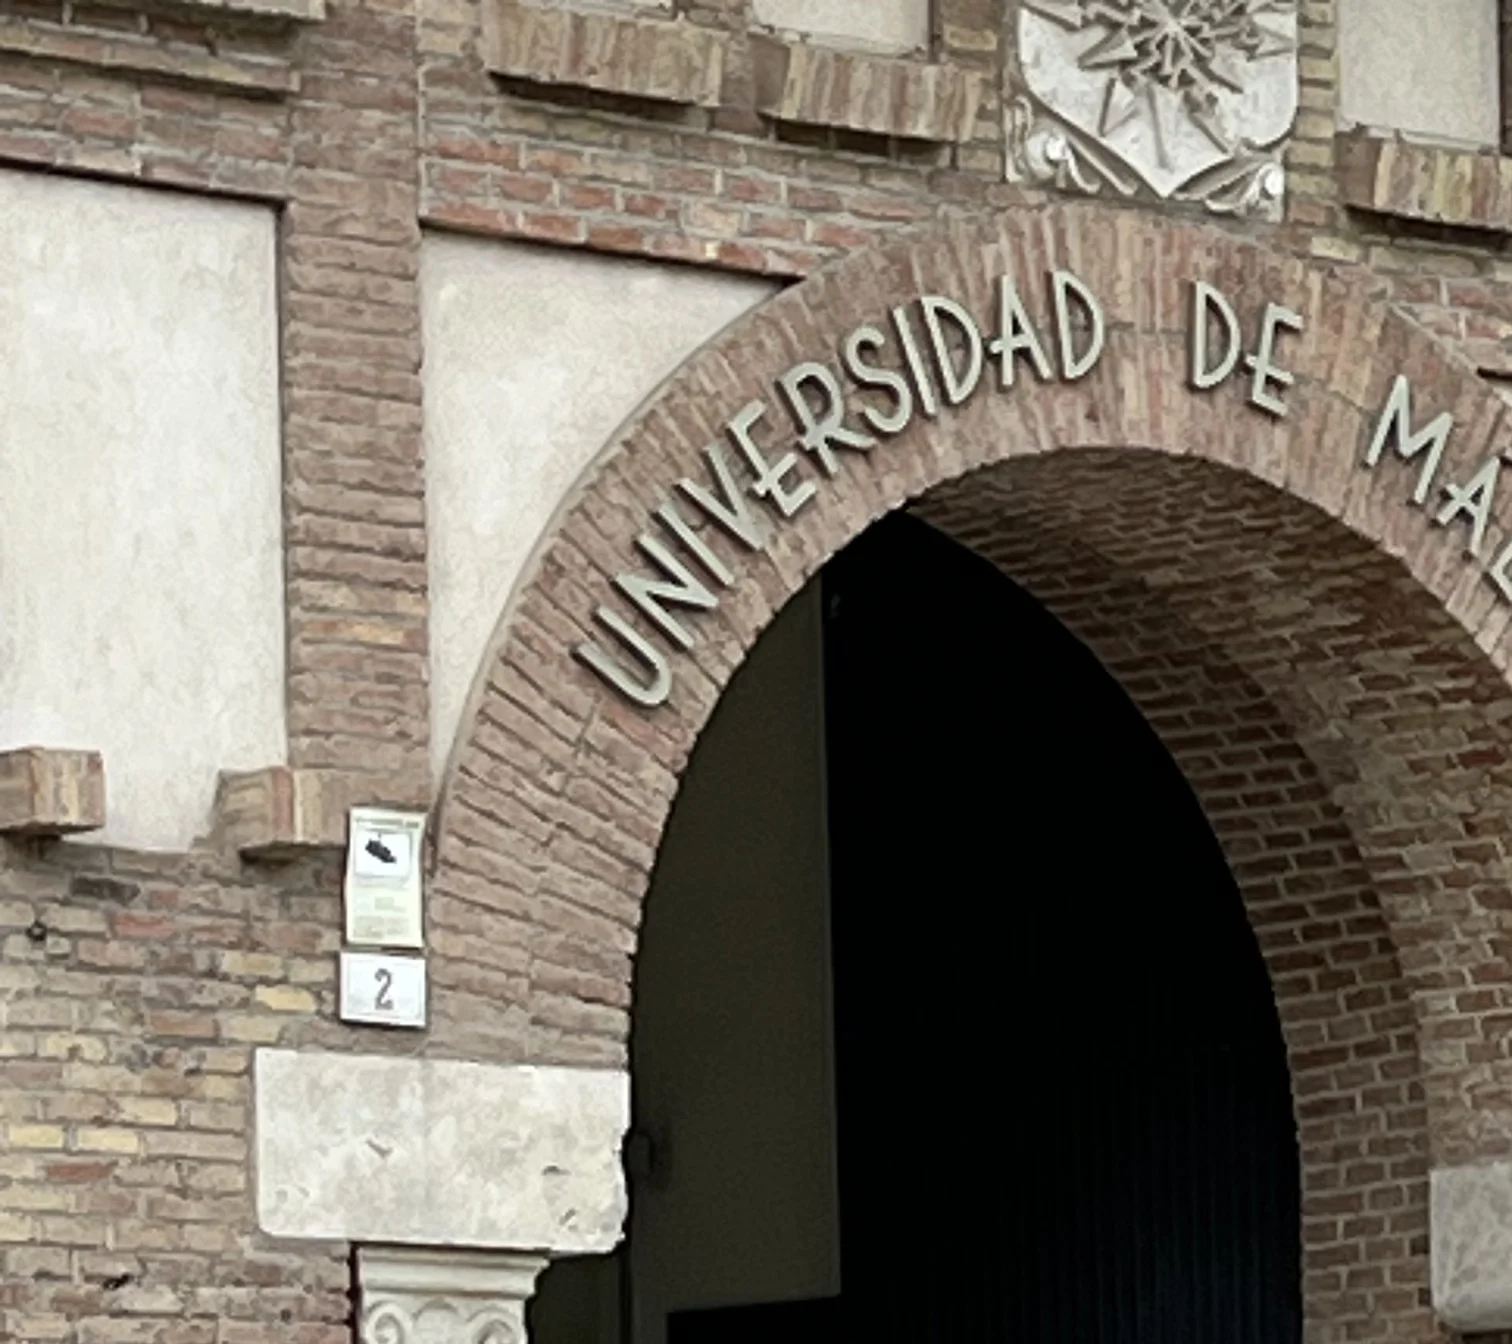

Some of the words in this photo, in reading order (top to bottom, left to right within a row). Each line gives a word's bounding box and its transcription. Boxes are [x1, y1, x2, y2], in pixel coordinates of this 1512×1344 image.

[570, 269, 1105, 709] UNIVERSIDAD
[1189, 280, 1302, 418] DE
[374, 967, 394, 1011] 2
